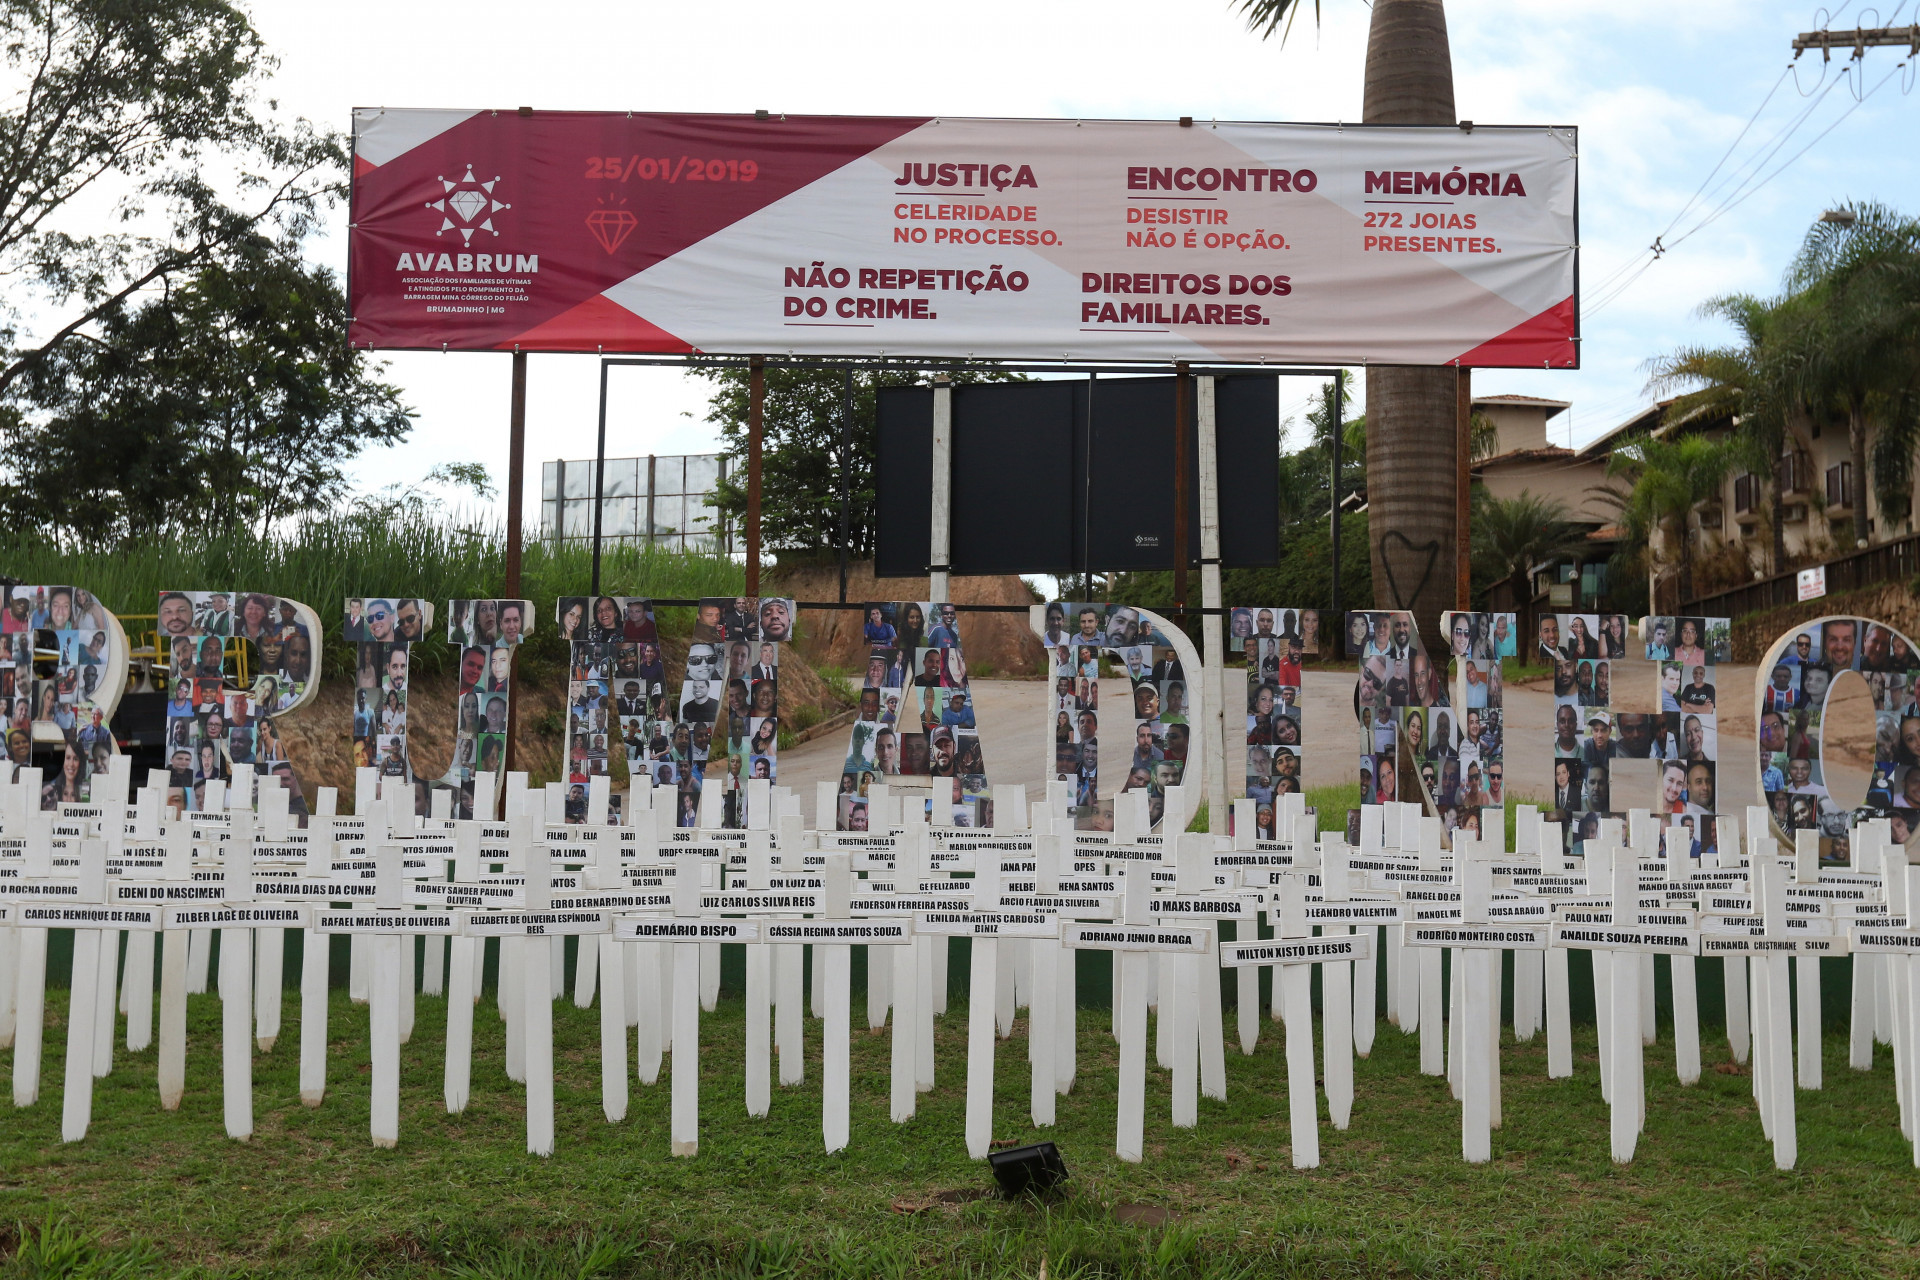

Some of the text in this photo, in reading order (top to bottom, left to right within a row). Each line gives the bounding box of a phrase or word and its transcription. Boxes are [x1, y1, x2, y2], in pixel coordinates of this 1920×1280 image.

[585, 156, 758, 184] 25/01/2019
[895, 163, 1038, 192] JUSTIÇA
[1127, 167, 1318, 193] ENCONTRO
[1364, 165, 1527, 197] MEMÓRIA
[894, 203, 1037, 222] CELERIDADE
[1126, 207, 1229, 225] DESISTIR
[1364, 212, 1477, 230] 272 JOIAS
[894, 227, 1063, 247] NO PROCESSO.
[1126, 227, 1291, 254] NÃO É OPÇÃO.
[1364, 235, 1502, 254] PRESENTES.
[396, 253, 539, 273] AVABRUM
[402, 277, 444, 285] ASSOCIAÇÃO
[505, 277, 532, 285] VÍTIMAS
[784, 261, 1029, 297] NÃO REPETIÇÃO
[1082, 272, 1292, 296] DIREITOS DOS
[506, 294, 529, 302] FEIJÃO
[784, 297, 937, 320] DO CRIME.
[1081, 302, 1270, 326] FAMILIARES.
[57, 826, 79, 836] ÁVILA
[546, 831, 568, 841] FILHO
[838, 838, 868, 846] CRISTINA
[949, 843, 977, 851] MARLON
[276, 848, 307, 857] SANTOS
[425, 845, 454, 854] JÚNIOR
[564, 849, 586, 858] LIMA
[1105, 851, 1144, 860] APARECIDO
[1220, 856, 1269, 866] MOREIRA DA
[632, 879, 662, 887] DA SILVA
[1385, 872, 1420, 882] ROSILENE
[1540, 876, 1569, 886] AURÉLIO
[256, 882, 342, 895] ROSÁRIA DIAS DA
[808, 879, 822, 888] DA
[930, 882, 970, 891] FELIZARDO
[1081, 882, 1115, 891] SANTOS
[1682, 882, 1704, 890] SILVA
[9, 885, 40, 895] ROCHA
[118, 887, 164, 899] EDENI DO
[415, 884, 514, 897] RODNEY SANDER PAULINO
[1406, 891, 1449, 901] RANGEL DO
[1538, 886, 1573, 894] BARCELOS
[1836, 890, 1864, 899] ROCHA
[446, 896, 482, 905] OLIVEIRA
[575, 895, 671, 908] BERNARDINO DE SENA
[721, 896, 815, 908] CARLOS SILVA REIS
[897, 901, 969, 911] FERREIRA PASSOS
[1053, 898, 1100, 907] DA SILVEIRA
[1712, 898, 1821, 913] EDIRLEY CAMPOS
[1193, 901, 1241, 913] BARBOSA
[1311, 907, 1397, 918] LEANDRO VALENTIM
[1417, 910, 1449, 919] MANOEL
[1514, 904, 1545, 915] ARAÚJO
[1855, 905, 1879, 914] EUDES
[25, 909, 151, 922] CARLOS HENRIQUE DE FARIA
[176, 910, 299, 923] ZILBER LAGE DE OLIVEIRA
[470, 912, 601, 925] ELIZABETE DE OLIVEIRA ESPÍNDOLA
[926, 914, 1046, 924] LENILDA MARTINS CARDOSO
[1565, 913, 1687, 925] PAULO OLIVEIRA
[1723, 916, 1764, 927] FELIPE JOSÉ
[321, 917, 450, 927] RAFAEL MATEUS DE OLIVEIRA
[1855, 918, 1890, 928] FRANCIS
[635, 923, 737, 936] ADEMÁRIO BISPO
[769, 924, 902, 937] CÁSSIA REGINA SANTOS SOUZA
[974, 924, 998, 933] DINIZ
[1079, 931, 1192, 944] ADRIANO JUNIO BRAGA
[1416, 930, 1536, 942] RODRIGO MONTEIRO COSTA
[1560, 930, 1688, 946] ANAILDE SOUZA PEREIRA
[1859, 934, 1908, 947] WALISSON
[1236, 943, 1352, 960] MILTON XISTO DE JESUS
[1706, 941, 1830, 951] FERNANDA SILVA
